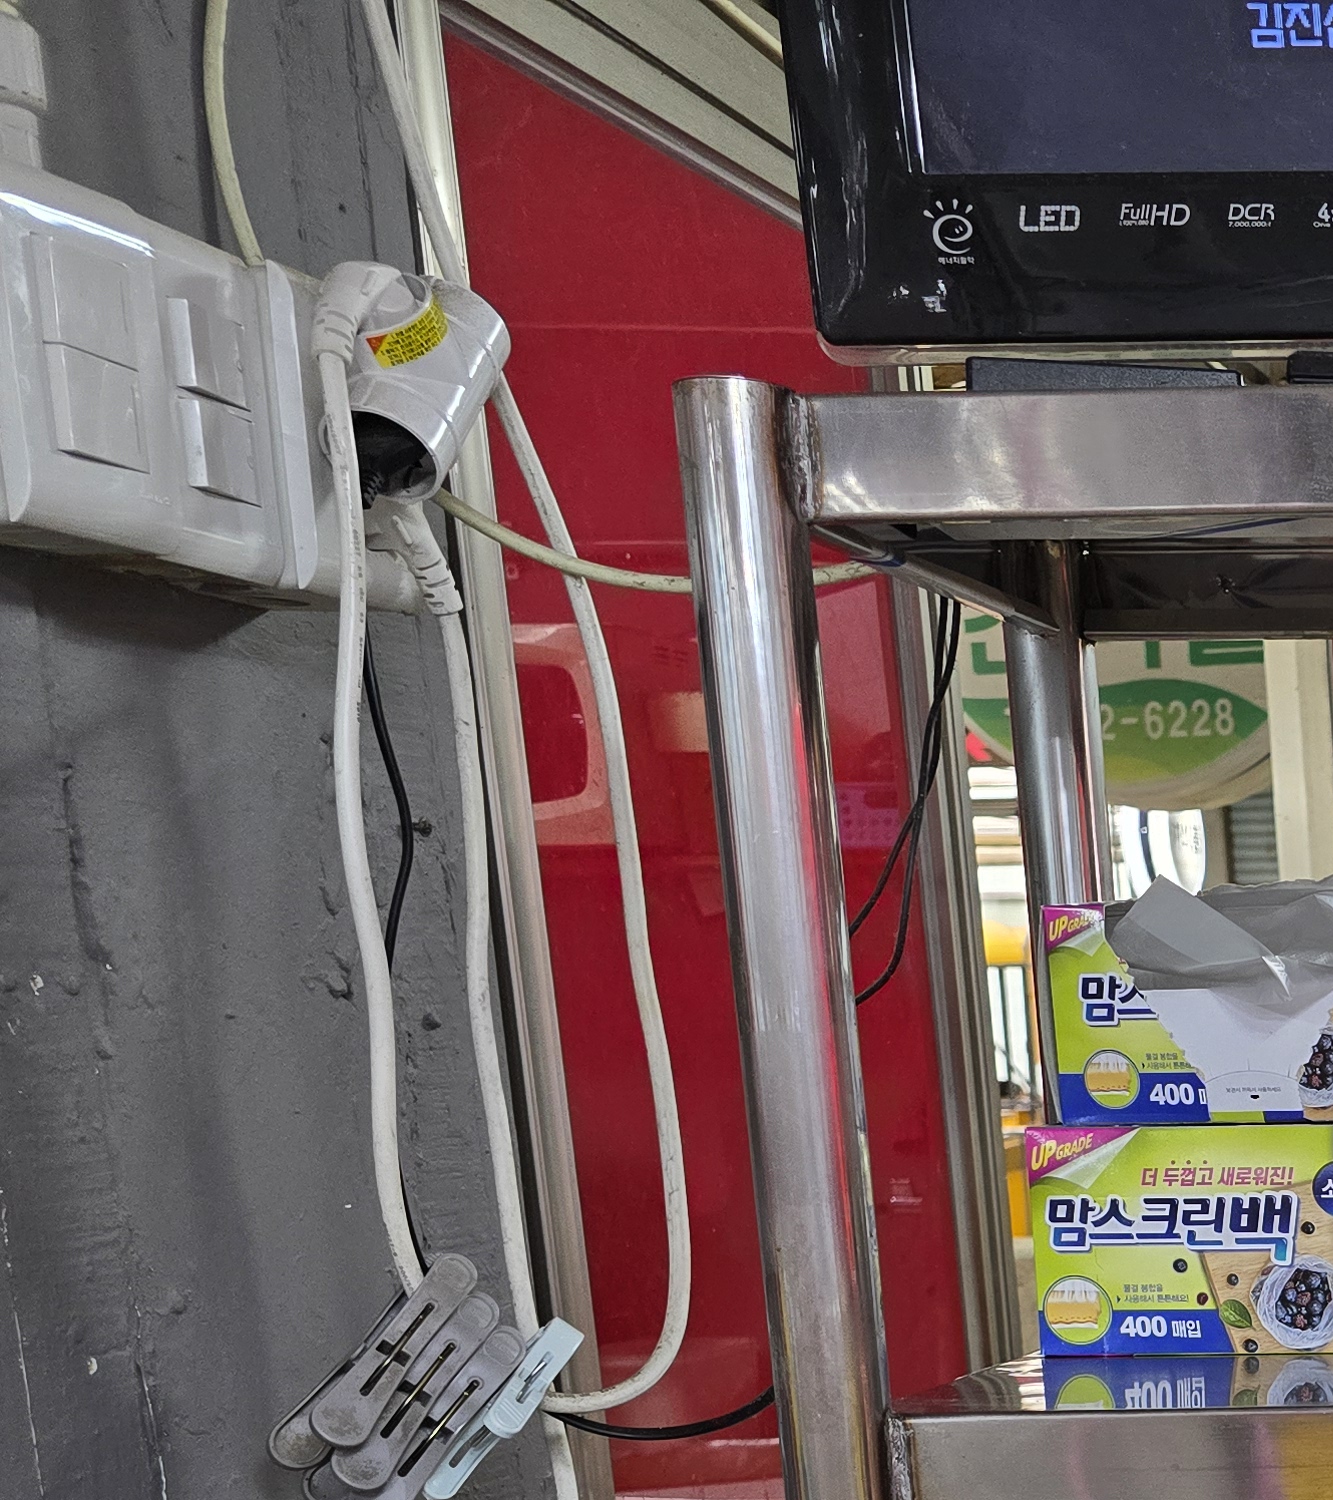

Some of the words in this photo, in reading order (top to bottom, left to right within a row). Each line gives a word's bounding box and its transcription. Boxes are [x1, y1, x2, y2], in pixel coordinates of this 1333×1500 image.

[1019, 204, 1081, 232] LED
[1227, 203, 1275, 220] DCR
[1149, 1083, 1194, 1106] 400
[1140, 1167, 1157, 1187] 더
[1162, 1166, 1213, 1187] 두껍고
[1217, 1166, 1294, 1186] 새로워진!
[1047, 1192, 1295, 1263] 맘스크린백
[1119, 1315, 1168, 1337] 400
[1171, 1319, 1202, 1338] 매입
